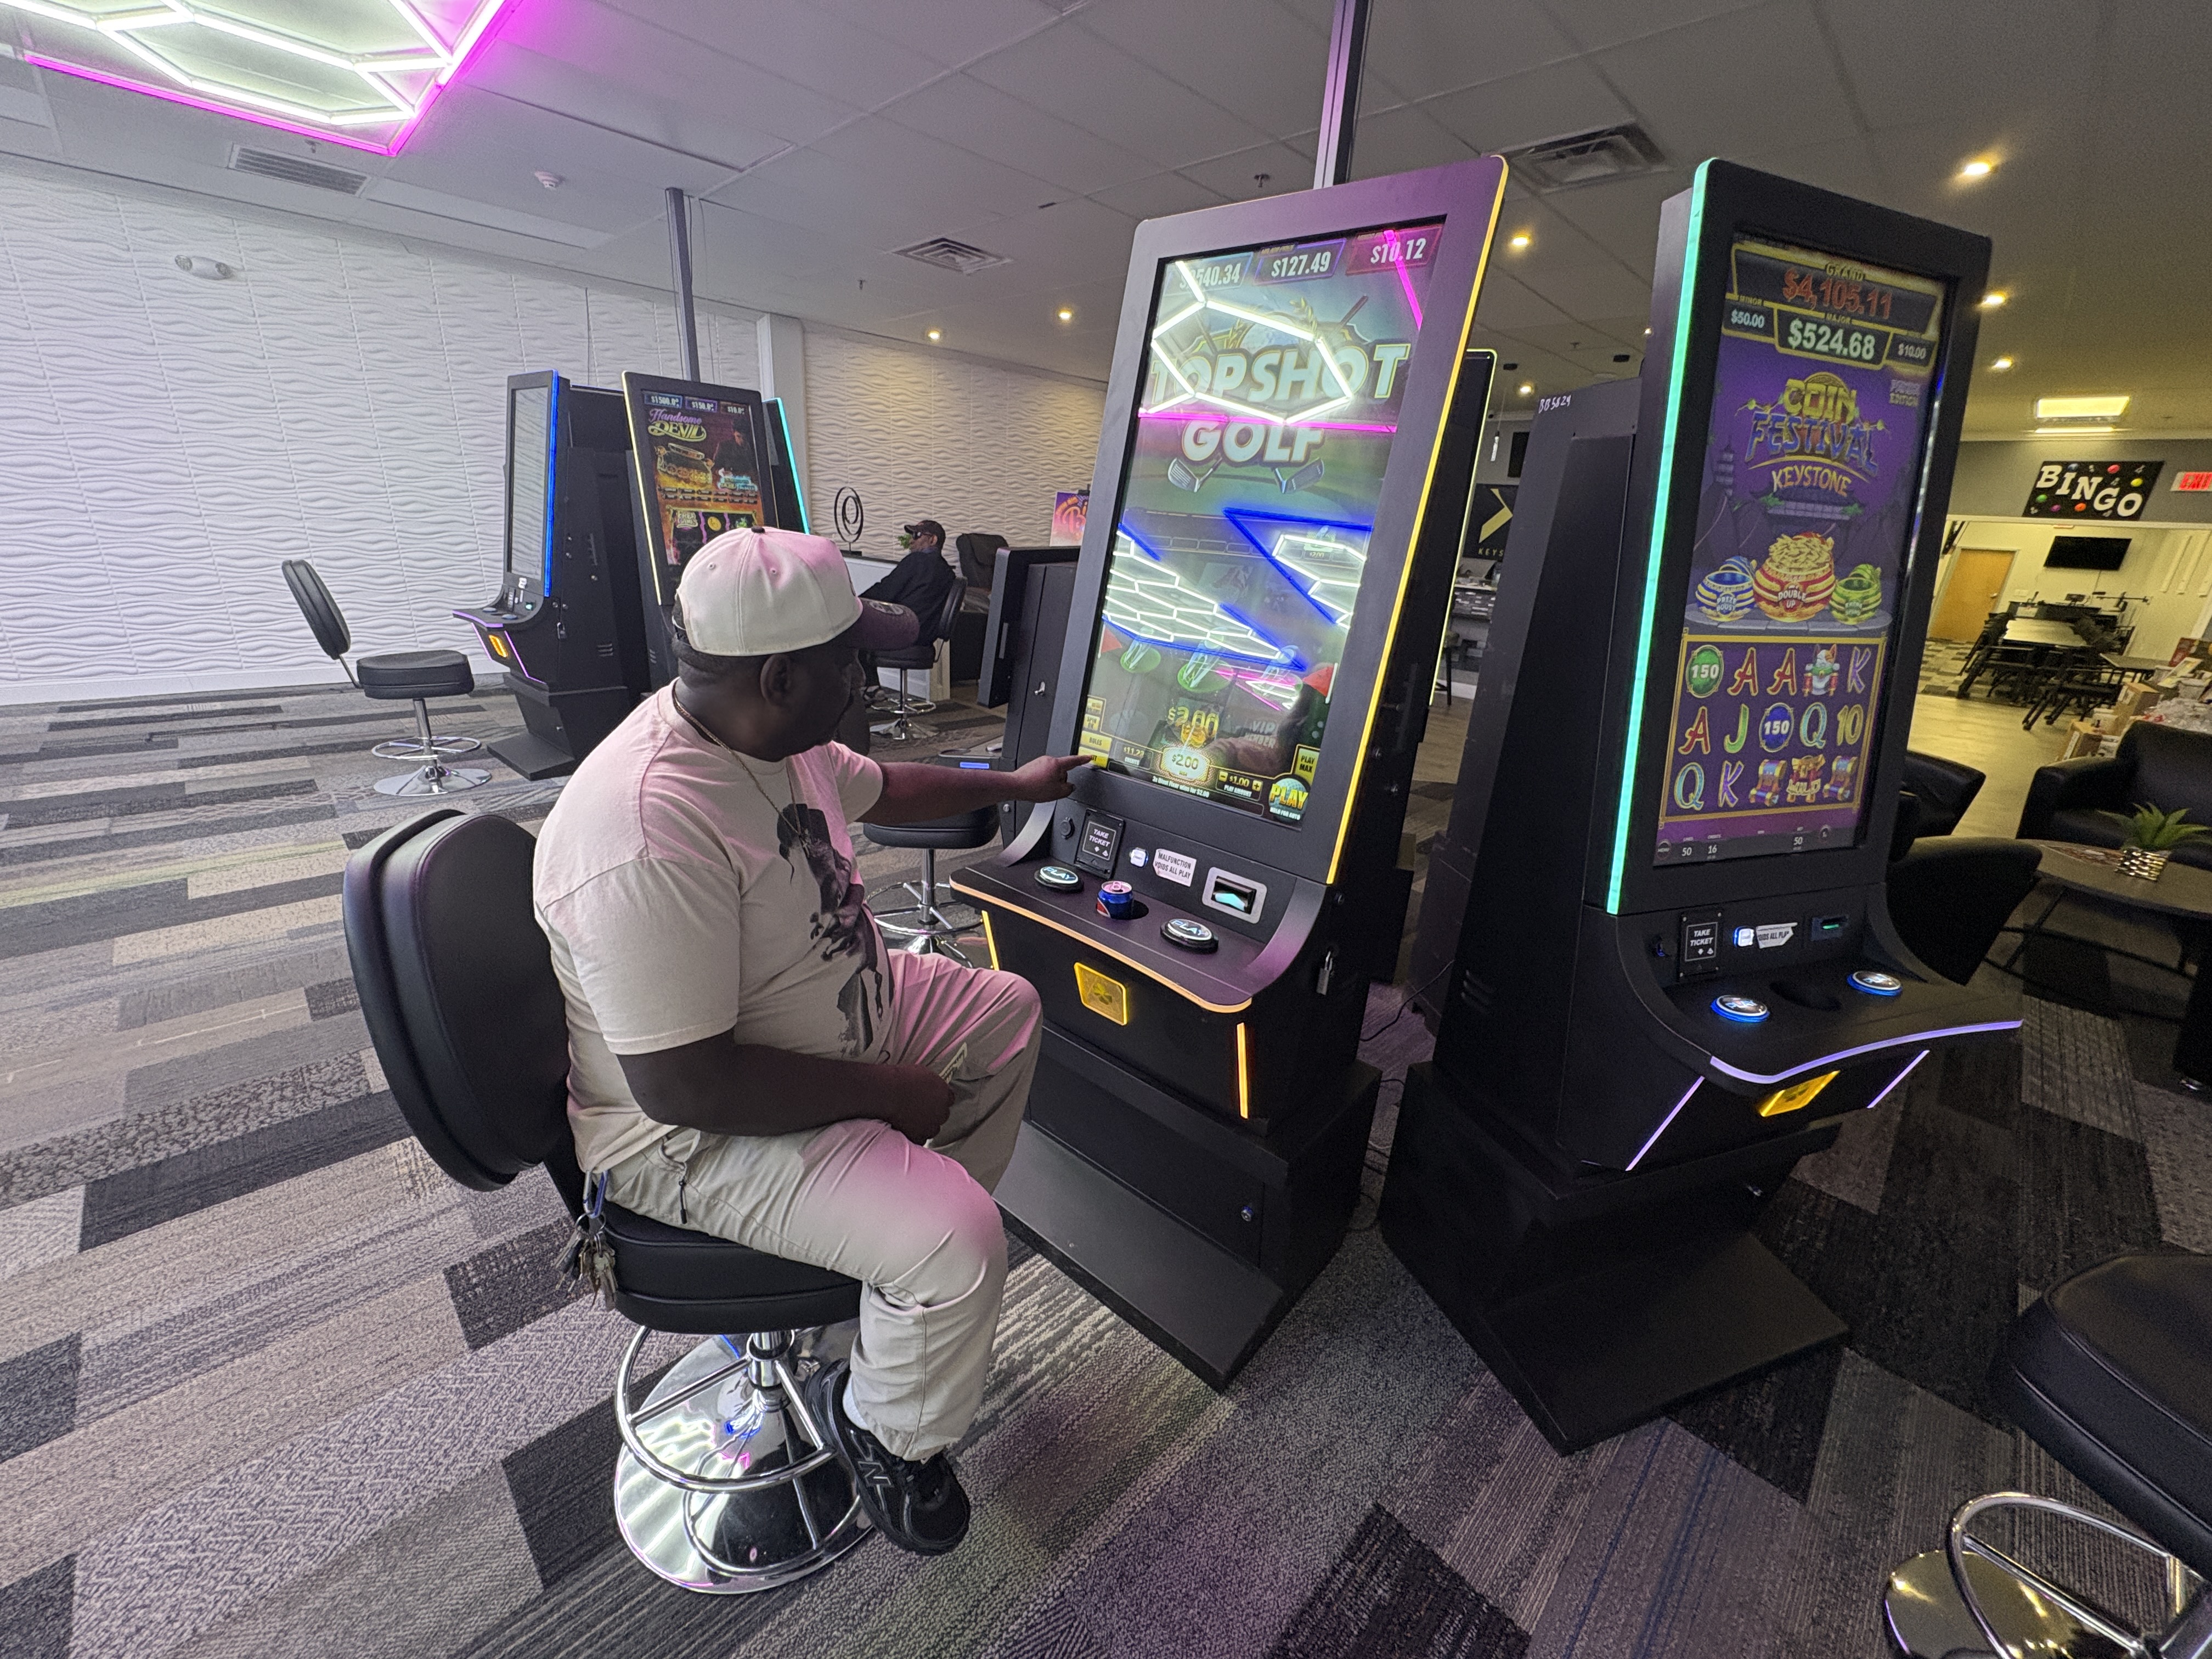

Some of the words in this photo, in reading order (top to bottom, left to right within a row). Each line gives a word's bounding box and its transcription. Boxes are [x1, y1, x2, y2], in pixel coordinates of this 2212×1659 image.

[1271, 251, 1331, 278] $127.49
[1782, 267, 1892, 319] $4,105.11
[1731, 309, 1765, 328] $50.00
[1788, 318, 1875, 360] $524.68
[1782, 379, 1857, 422] COIN
[648, 408, 702, 425] Handsome
[648, 420, 707, 442] DEVIL
[1182, 419, 1324, 464] GOLF
[1746, 409, 1879, 476] FESTIVAL
[1772, 465, 1852, 496] KEYSTONE
[2035, 464, 2143, 517] BINGO
[1778, 591, 1807, 601] DOUBLE
[1786, 600, 1796, 608] UP
[1691, 663, 1719, 680] 150
[1728, 647, 1758, 696] A
[1767, 647, 1797, 696] A
[1847, 646, 1871, 693] K
[1678, 706, 1710, 755] A
[1724, 704, 1749, 753] J
[1764, 719, 1790, 736] 150
[1799, 702, 1827, 749] Q
[1836, 704, 1864, 746] 10
[1299, 764, 1313, 772] MAX
[1301, 755, 1315, 764] PLAY
[1229, 776, 1250, 787] $1.00
[1674, 762, 1705, 810] Q
[1718, 760, 1744, 808] K
[1269, 783, 1308, 810] PLAY
[1089, 835, 1110, 847] TICKET
[1094, 829, 1109, 839] TAKE
[1793, 836, 1803, 845] 50
[1681, 847, 1692, 856] 50
[1708, 844, 1717, 854] 16
[1158, 852, 1191, 870] MALFUNCTION
[1043, 867, 1075, 880] PLAY
[1155, 861, 1169, 871] VOIDS
[1178, 870, 1190, 879] PLAY
[1171, 920, 1209, 935] PLAY
[1694, 928, 1711, 937] TAKE
[1690, 937, 1713, 946] TICKET
[1725, 1000, 1758, 1009] PLAY
